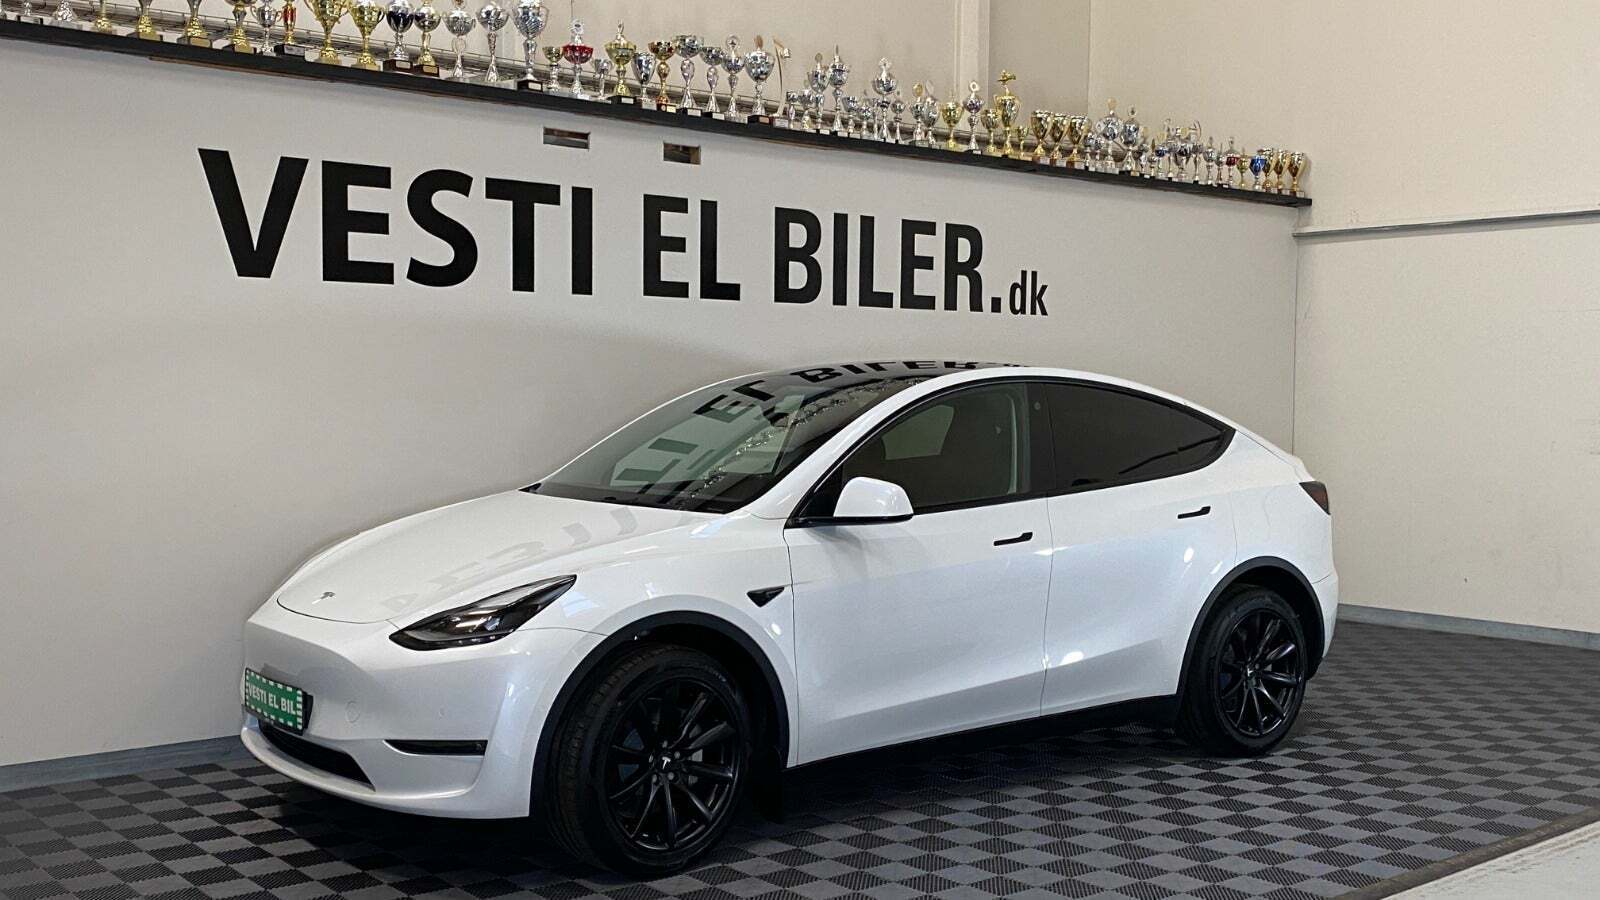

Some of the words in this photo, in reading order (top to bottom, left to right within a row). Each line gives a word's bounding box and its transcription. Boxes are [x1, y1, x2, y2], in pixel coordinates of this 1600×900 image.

[198, 148, 592, 296] VESTI
[643, 194, 740, 301] EL
[248, 682, 267, 705] VESTI
[268, 692, 279, 709] EL
[280, 697, 296, 715] BIL
